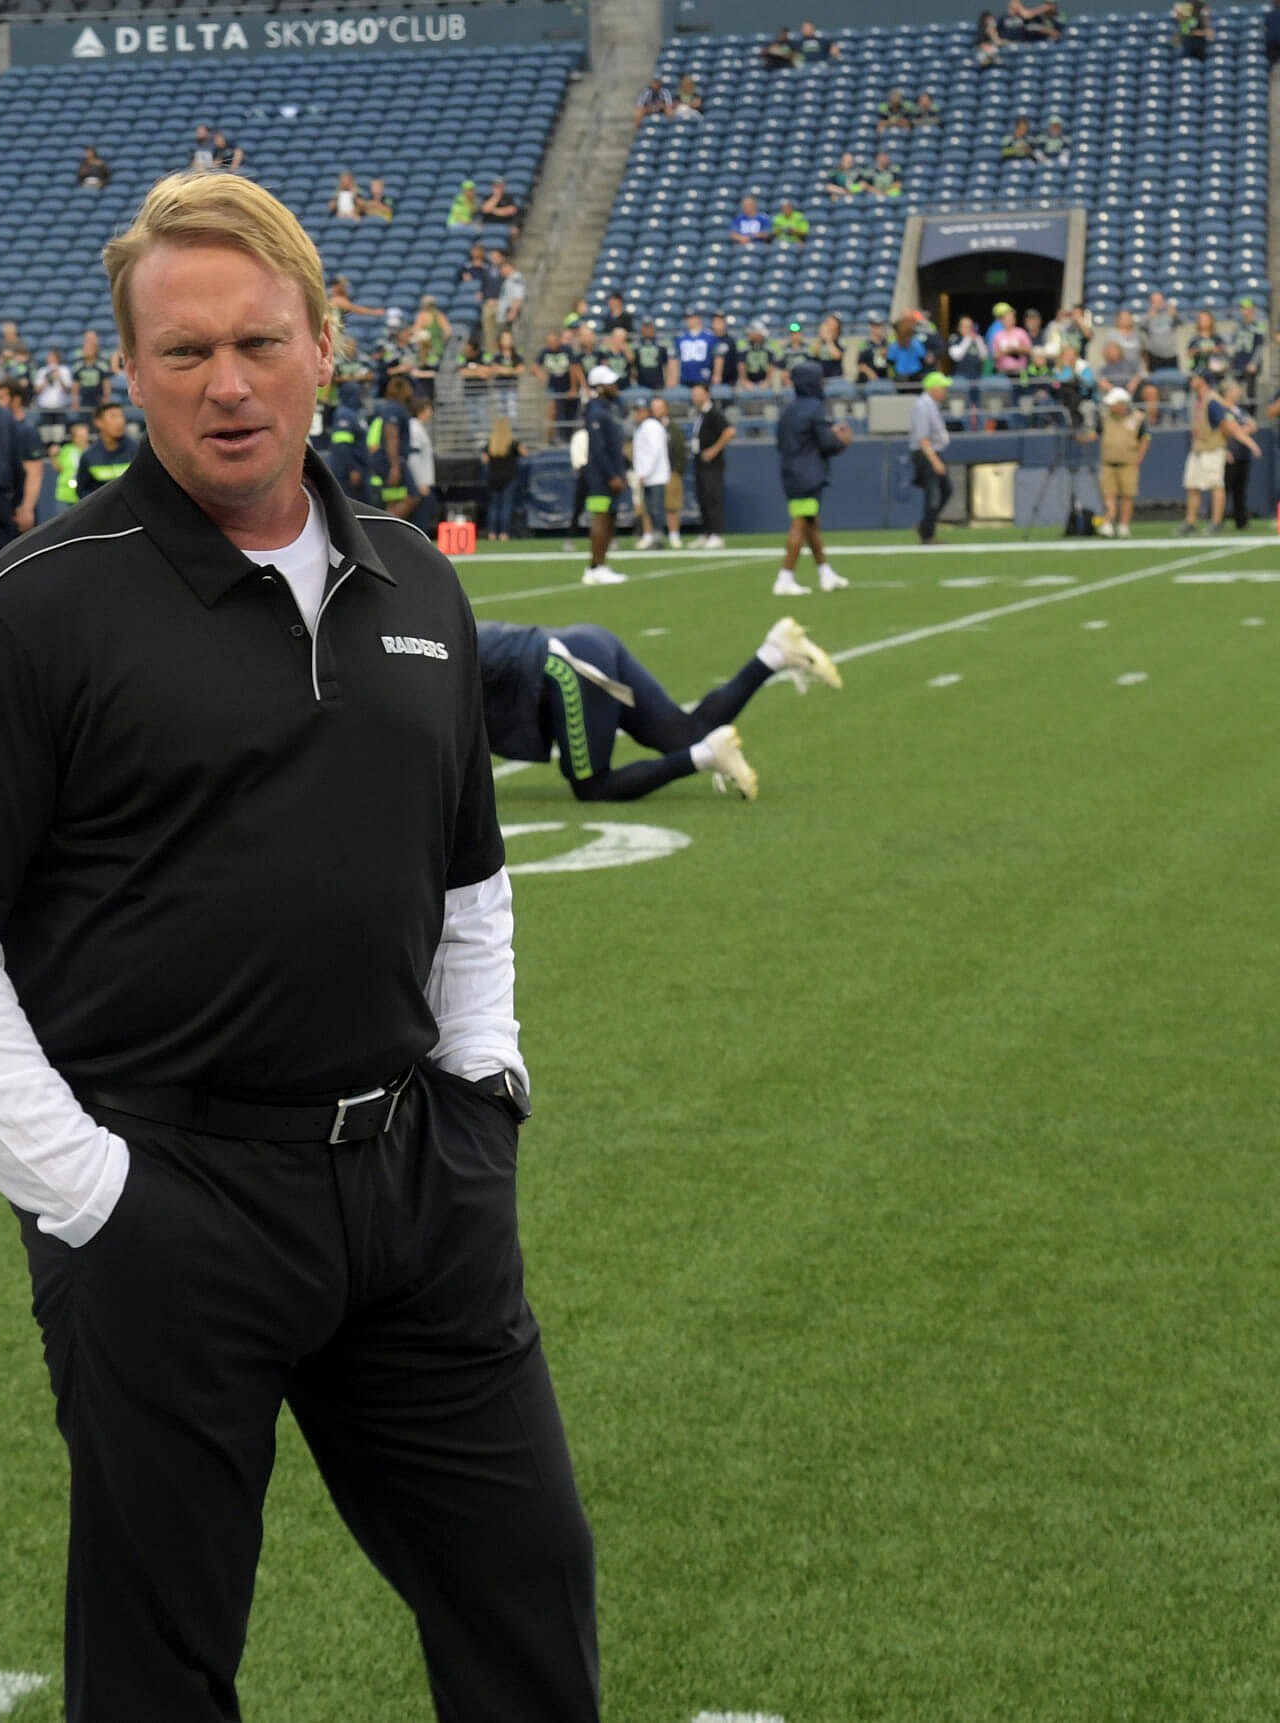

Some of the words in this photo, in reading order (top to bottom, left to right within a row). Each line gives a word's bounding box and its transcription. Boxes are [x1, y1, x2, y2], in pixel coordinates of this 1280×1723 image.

[116, 22, 248, 53] DELTA
[445, 528, 469, 553] 10
[381, 636, 448, 660] RAIDERS
